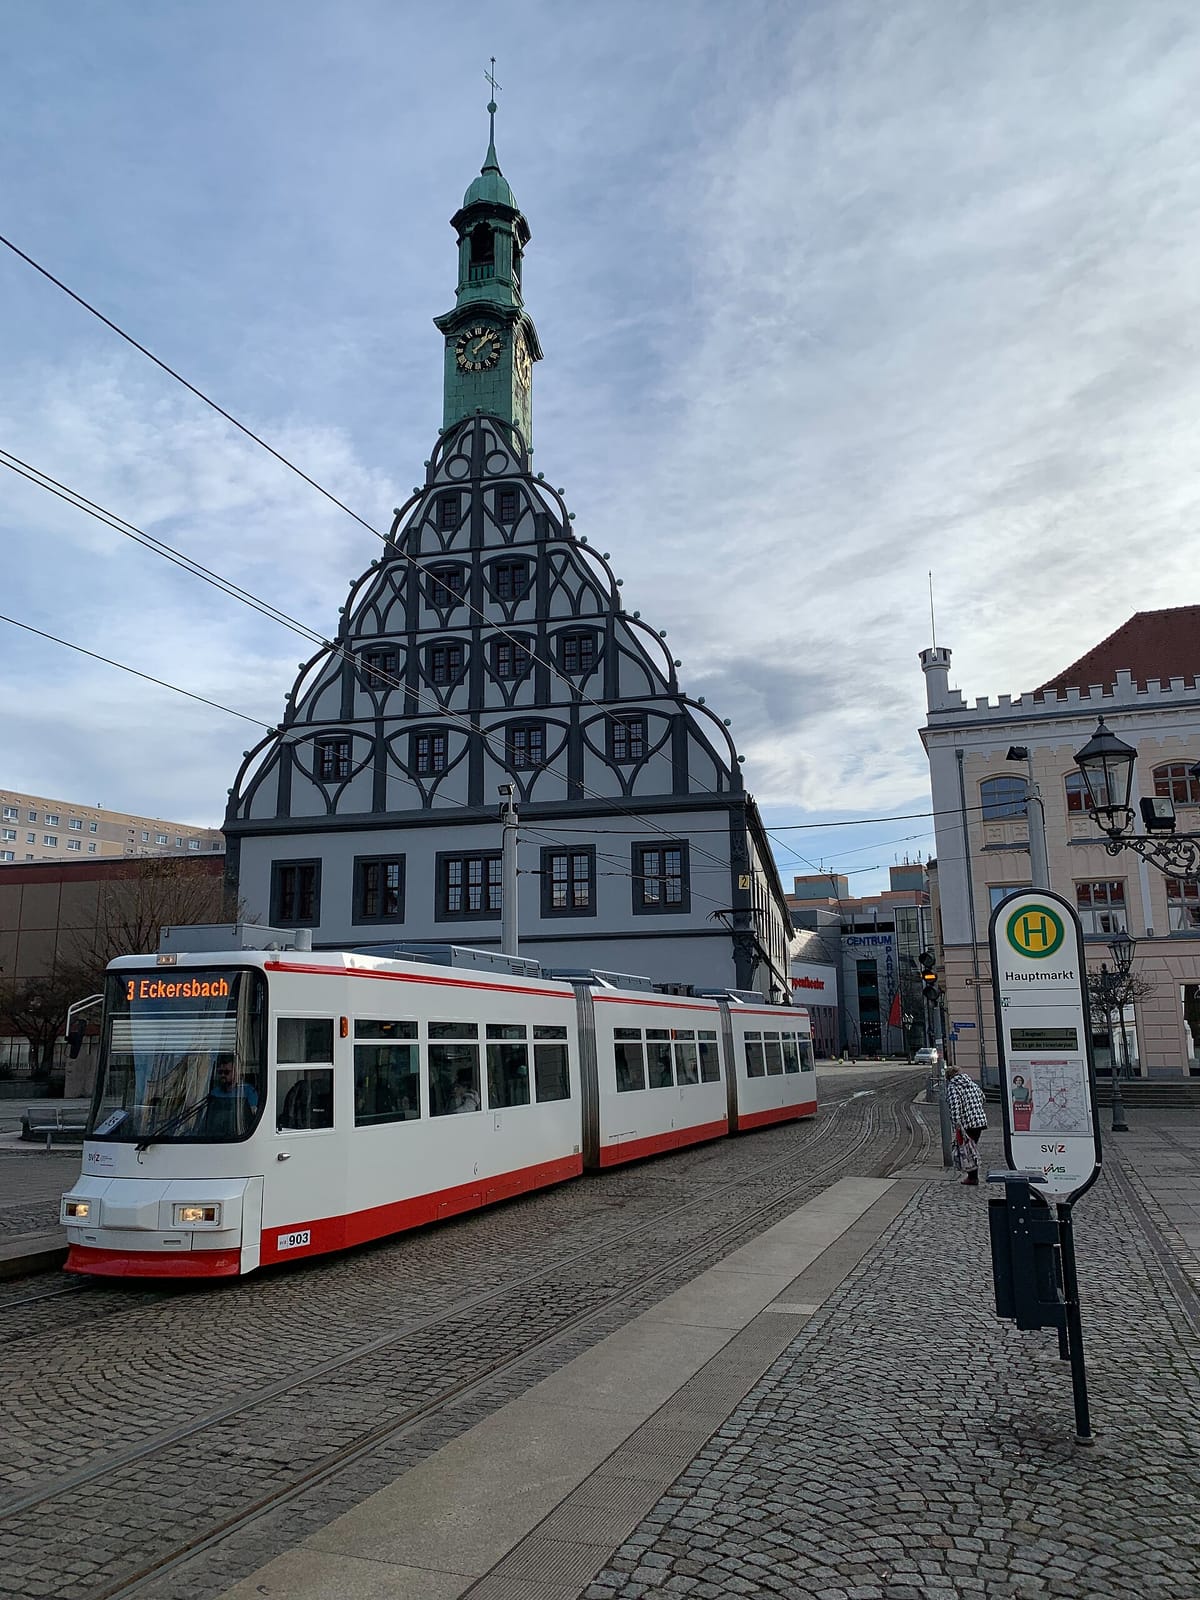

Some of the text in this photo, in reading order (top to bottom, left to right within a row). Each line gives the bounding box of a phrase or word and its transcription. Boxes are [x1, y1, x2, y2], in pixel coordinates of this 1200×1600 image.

[846, 935, 892, 947] CENTRUM
[1023, 916, 1048, 947] H
[885, 946, 895, 1002] PARKHA
[1005, 970, 1075, 983] Hauptmarkt
[126, 977, 229, 1001] 3 Eckersbach
[288, 1232, 309, 1246] 903
